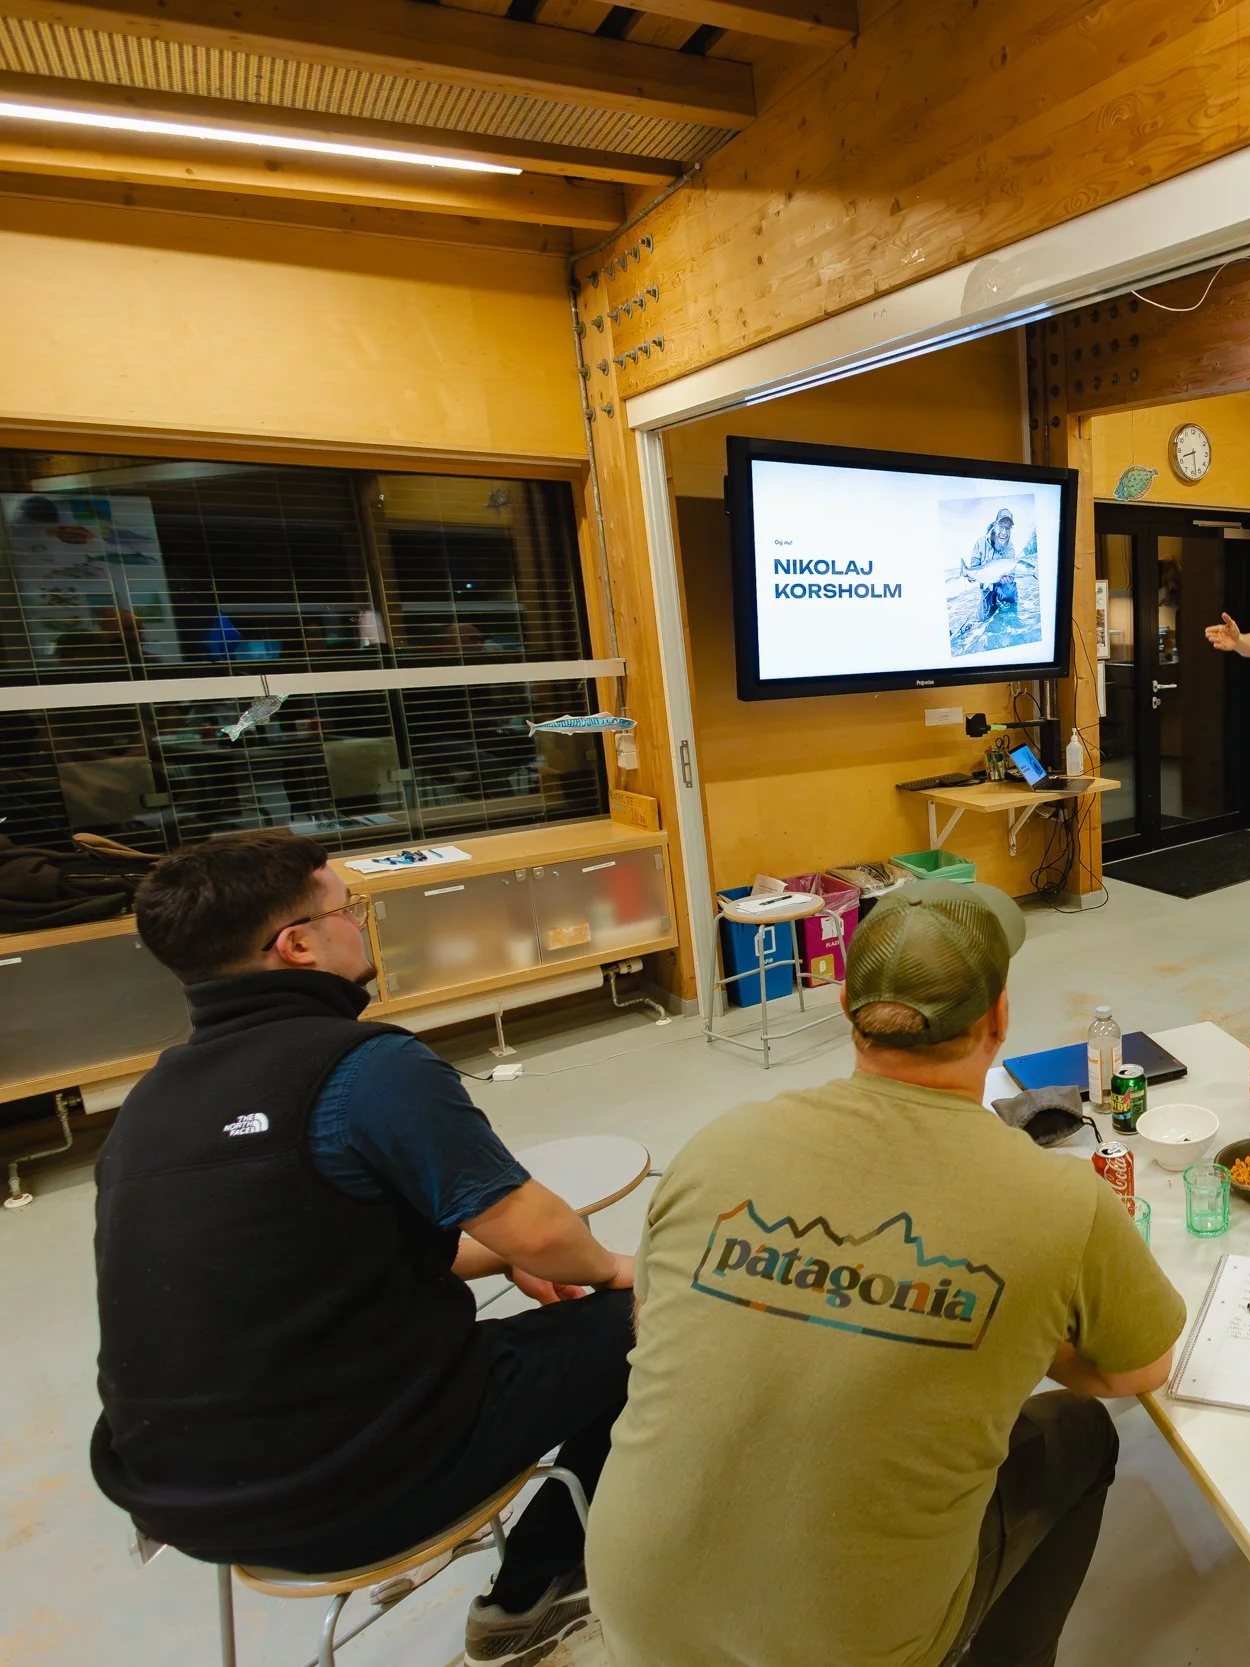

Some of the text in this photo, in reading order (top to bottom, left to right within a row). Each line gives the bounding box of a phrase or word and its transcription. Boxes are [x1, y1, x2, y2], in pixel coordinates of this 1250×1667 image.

[774, 559, 873, 576] NIKOLAJ
[774, 583, 902, 599] KORSHOLM
[237, 1113, 255, 1123] THE
[223, 1121, 253, 1132] NORTH
[229, 1127, 252, 1136] FACE
[712, 1237, 977, 1323] patagonia
